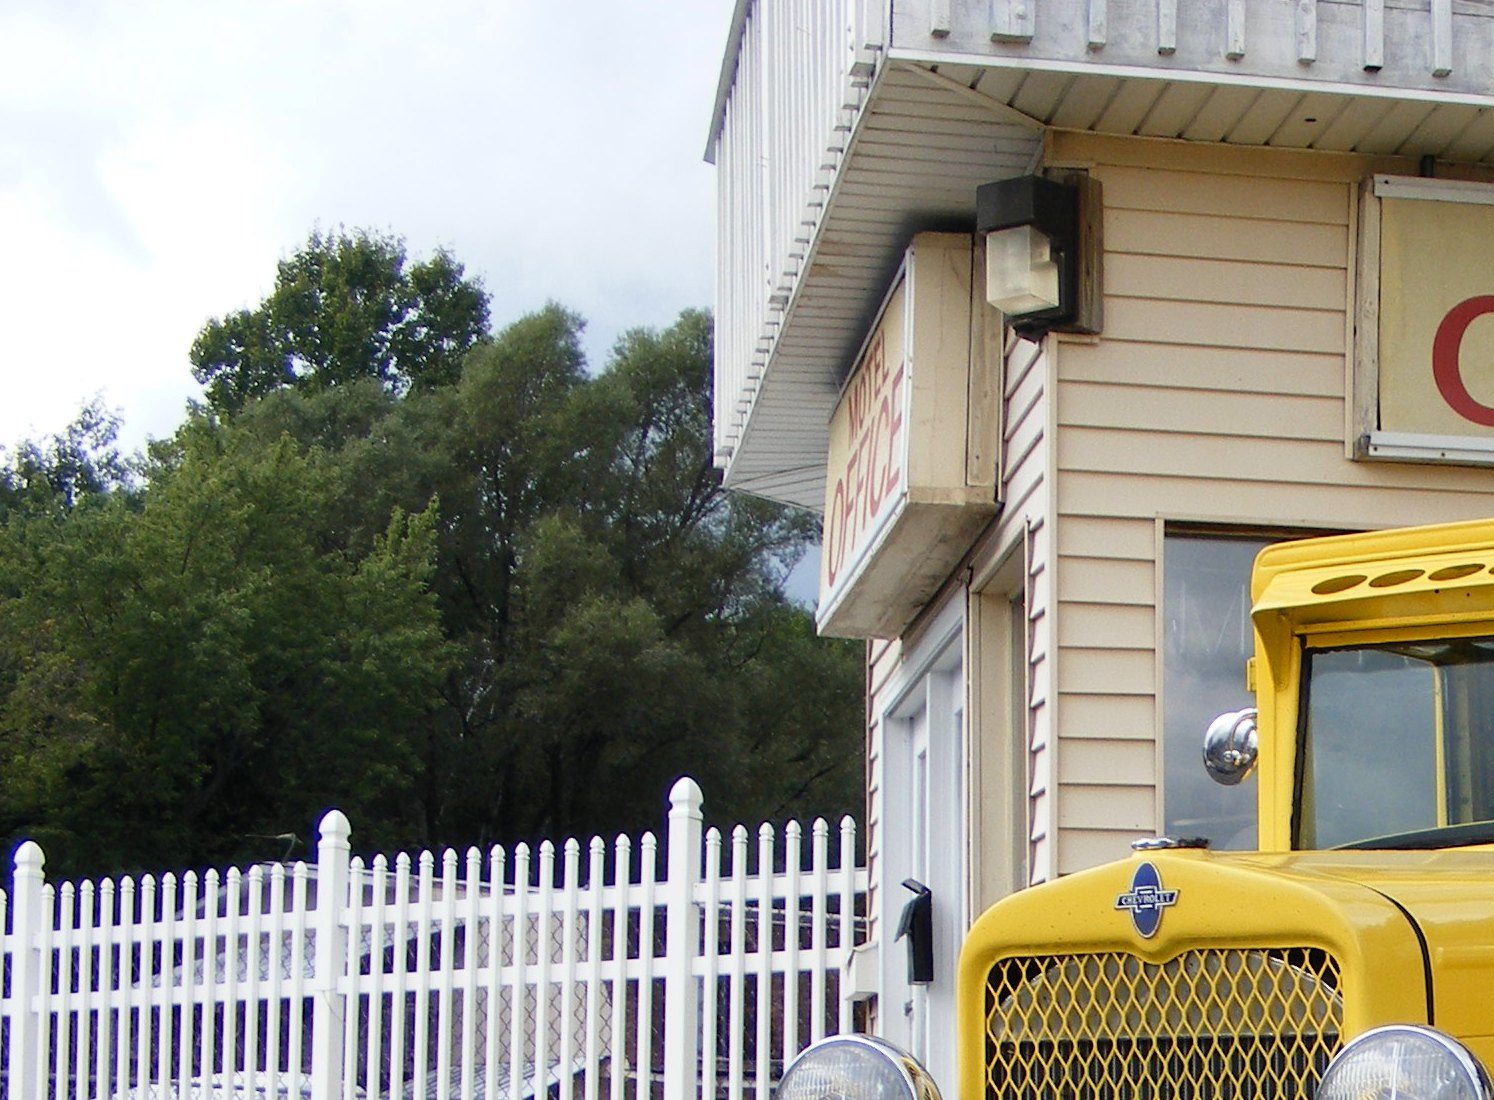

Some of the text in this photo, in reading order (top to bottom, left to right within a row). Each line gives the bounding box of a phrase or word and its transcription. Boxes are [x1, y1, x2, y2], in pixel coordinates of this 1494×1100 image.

[848, 329, 889, 441] MOTEL
[828, 361, 904, 588] OFFICE
[1121, 893, 1171, 905] CHEVROLET
